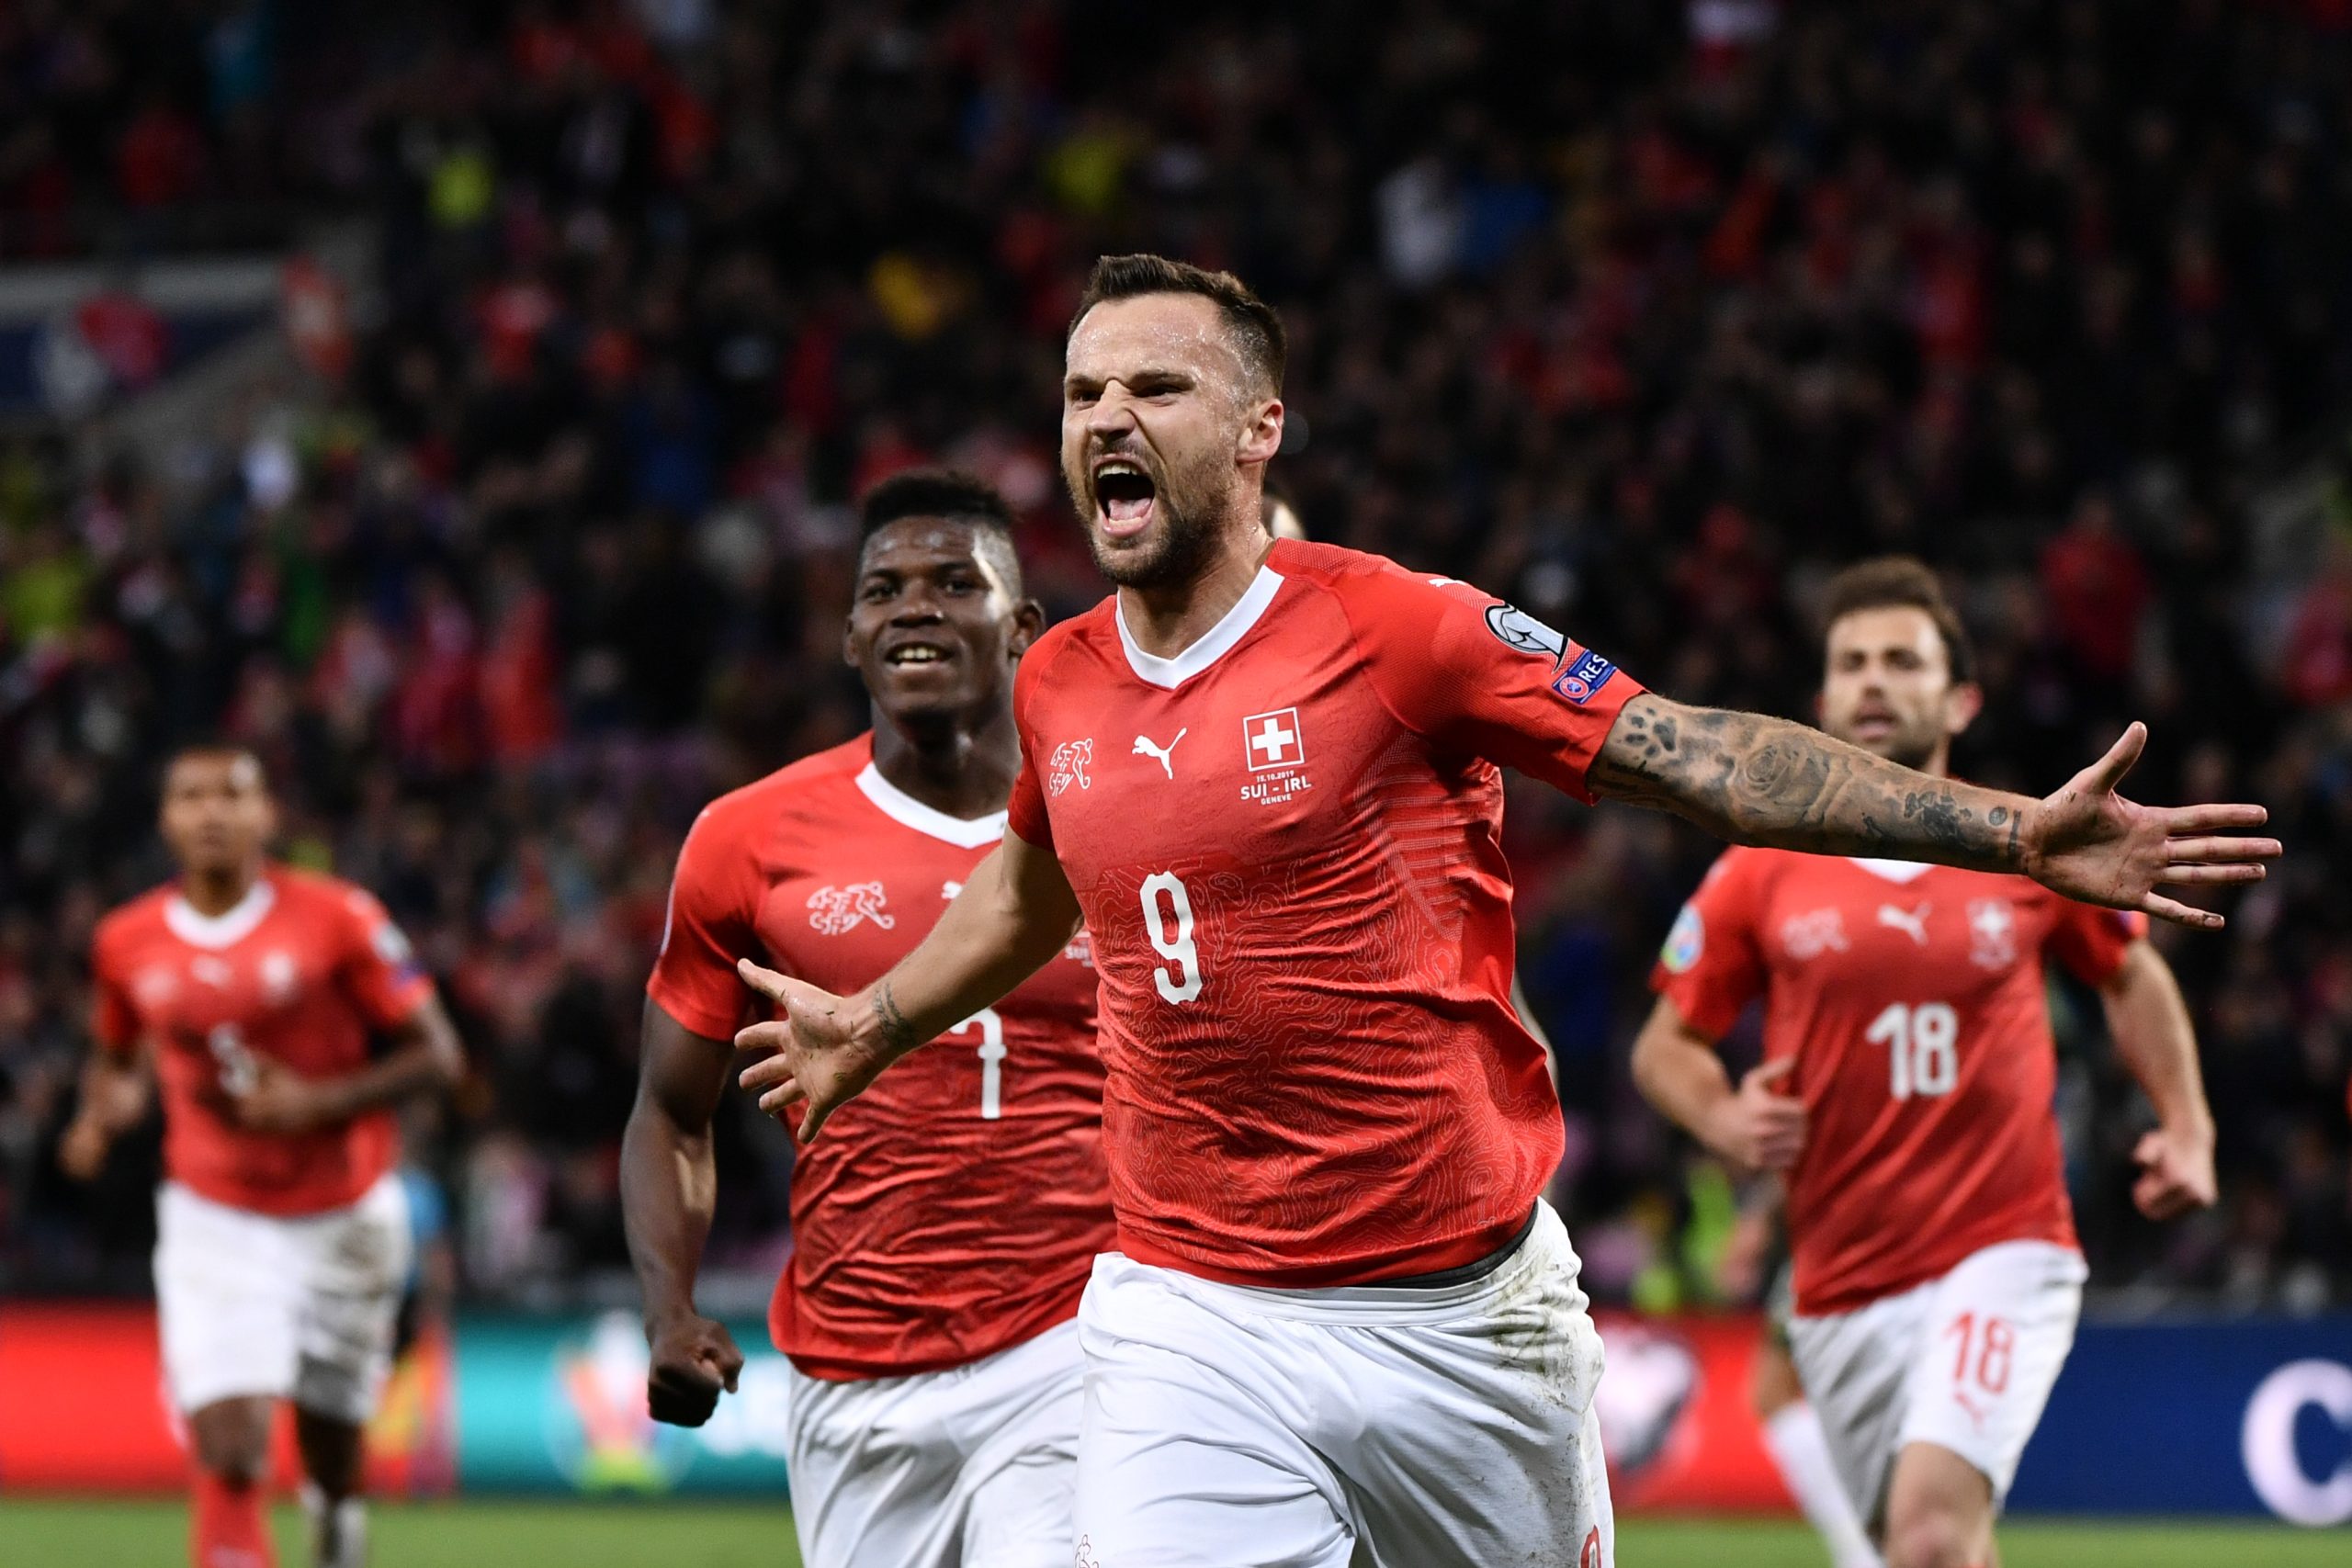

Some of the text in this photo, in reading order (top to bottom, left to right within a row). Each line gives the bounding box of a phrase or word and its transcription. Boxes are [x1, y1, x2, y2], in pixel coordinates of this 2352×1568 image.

[1578, 654, 1609, 682] RES
[1240, 783, 1267, 800] SUI
[1283, 775, 1312, 793] IRL
[1261, 794, 1292, 805] GENEVE
[1139, 871, 1203, 1005] 9
[949, 1006, 1008, 1120] 7
[1865, 1002, 1958, 1100] 18
[1940, 1311, 2014, 1396] 18
